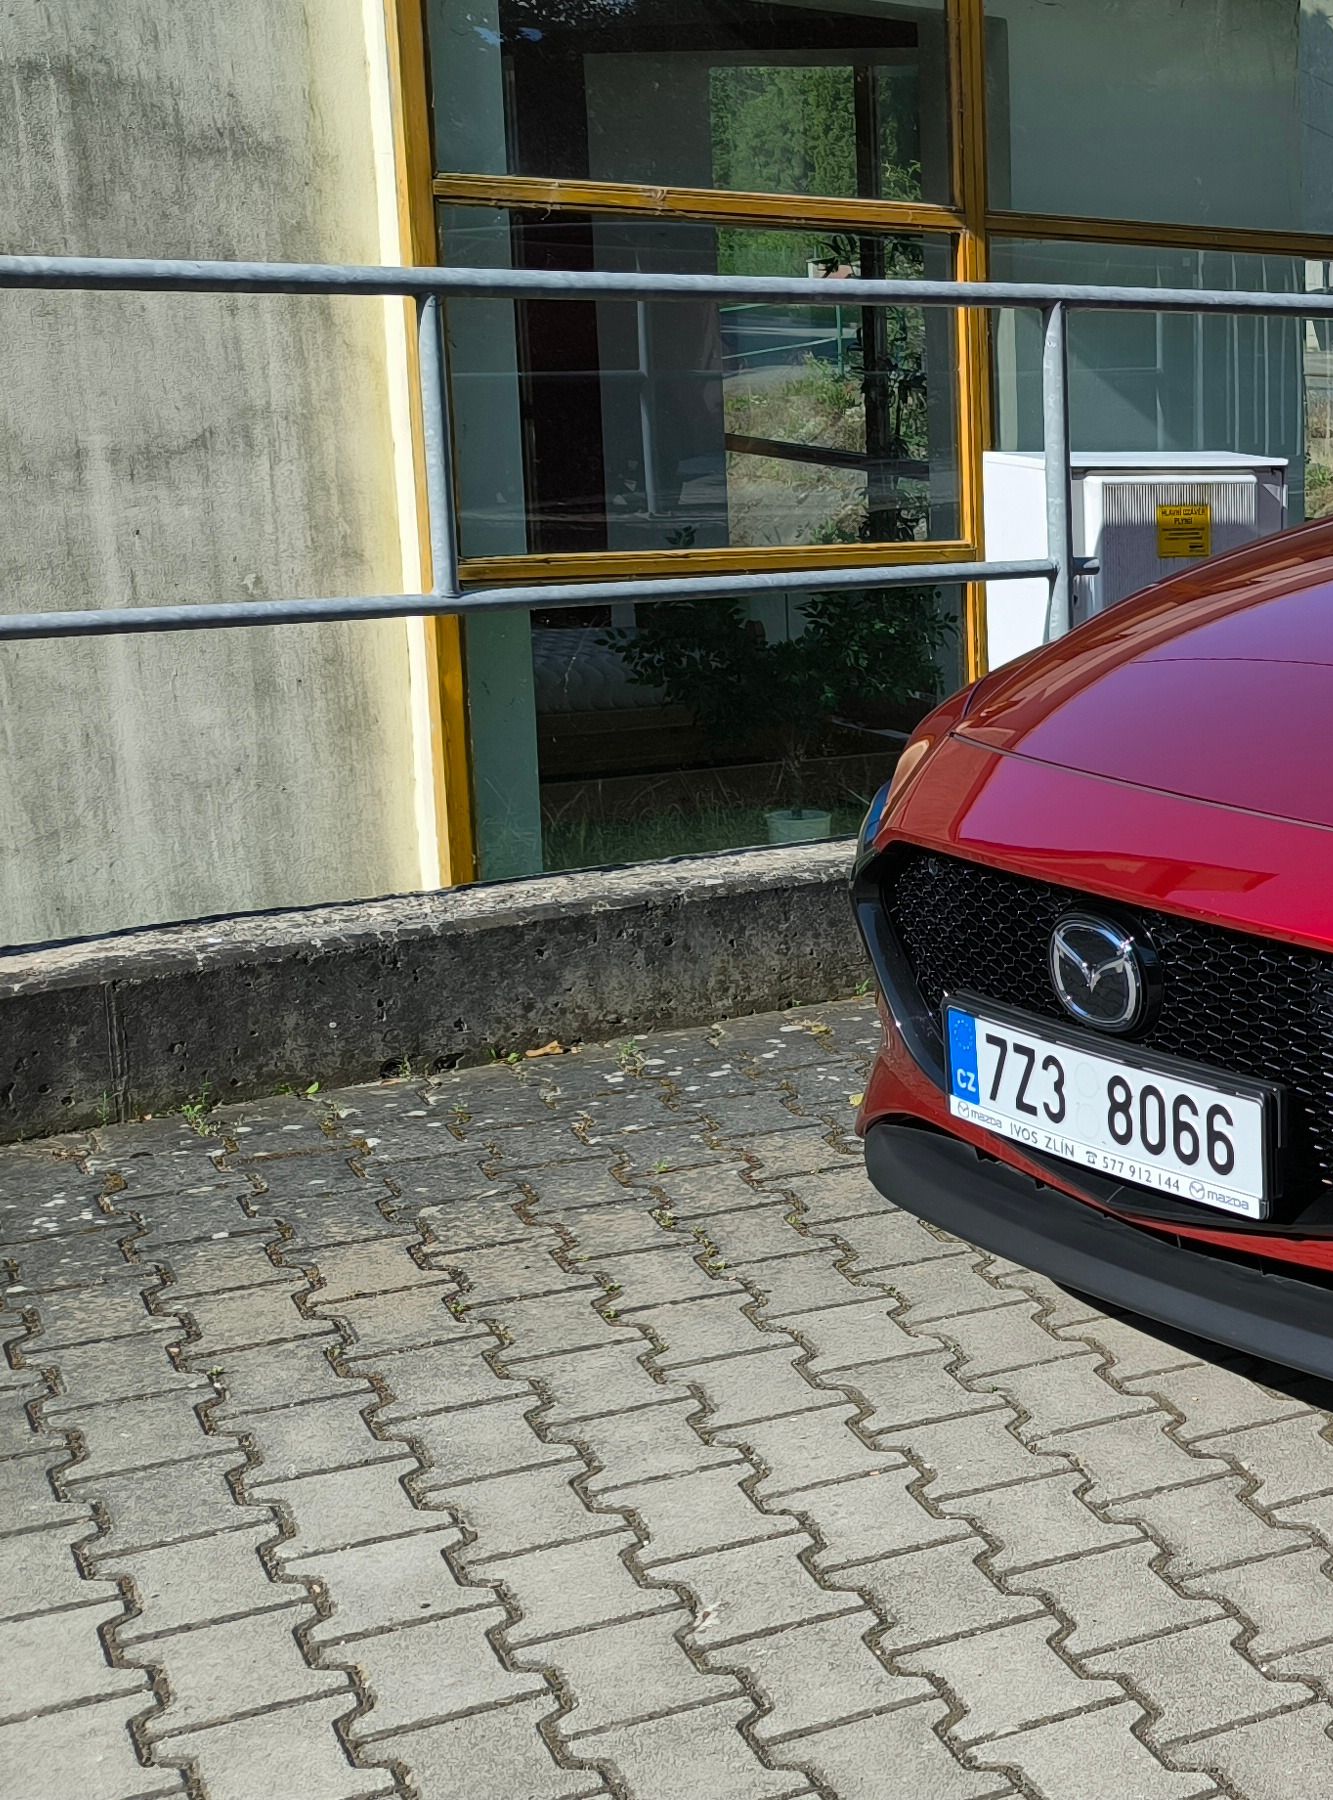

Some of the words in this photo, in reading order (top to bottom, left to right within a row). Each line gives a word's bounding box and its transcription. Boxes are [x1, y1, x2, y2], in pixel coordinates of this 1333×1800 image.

[956, 1068, 976, 1093] CZ
[985, 1033, 1066, 1124] 7Z3
[1107, 1075, 1235, 1176] 8066
[1010, 1122, 1038, 1144] IVOS
[1044, 1135, 1075, 1157] ZLÍN
[1102, 1156, 1124, 1173] 577
[1129, 1165, 1152, 1183] 912
[1158, 1173, 1180, 1191] 144
